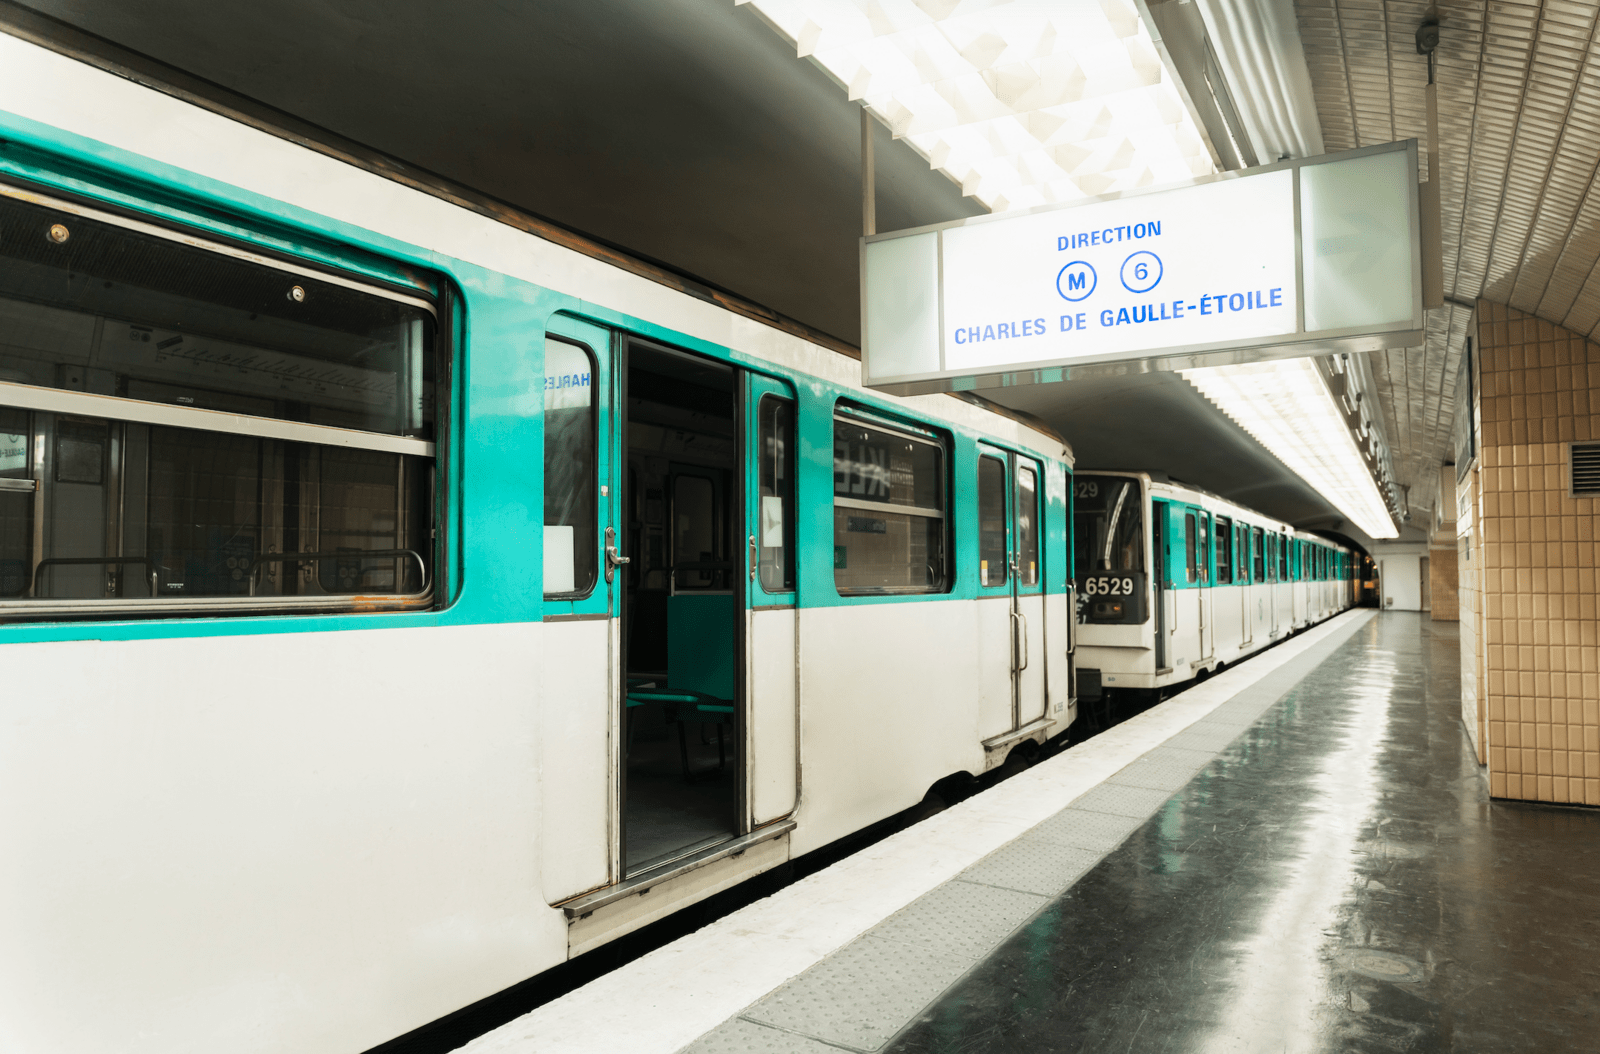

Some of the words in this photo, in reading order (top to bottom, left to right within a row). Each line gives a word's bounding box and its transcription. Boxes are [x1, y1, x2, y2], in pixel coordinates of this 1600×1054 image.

[1057, 220, 1162, 252] DIRECTION
[954, 319, 1047, 345] CHARLES
[1059, 312, 1087, 333] DE
[1099, 287, 1283, 328] GAULLE-ÉTOILE
[1085, 577, 1133, 595] 6529
